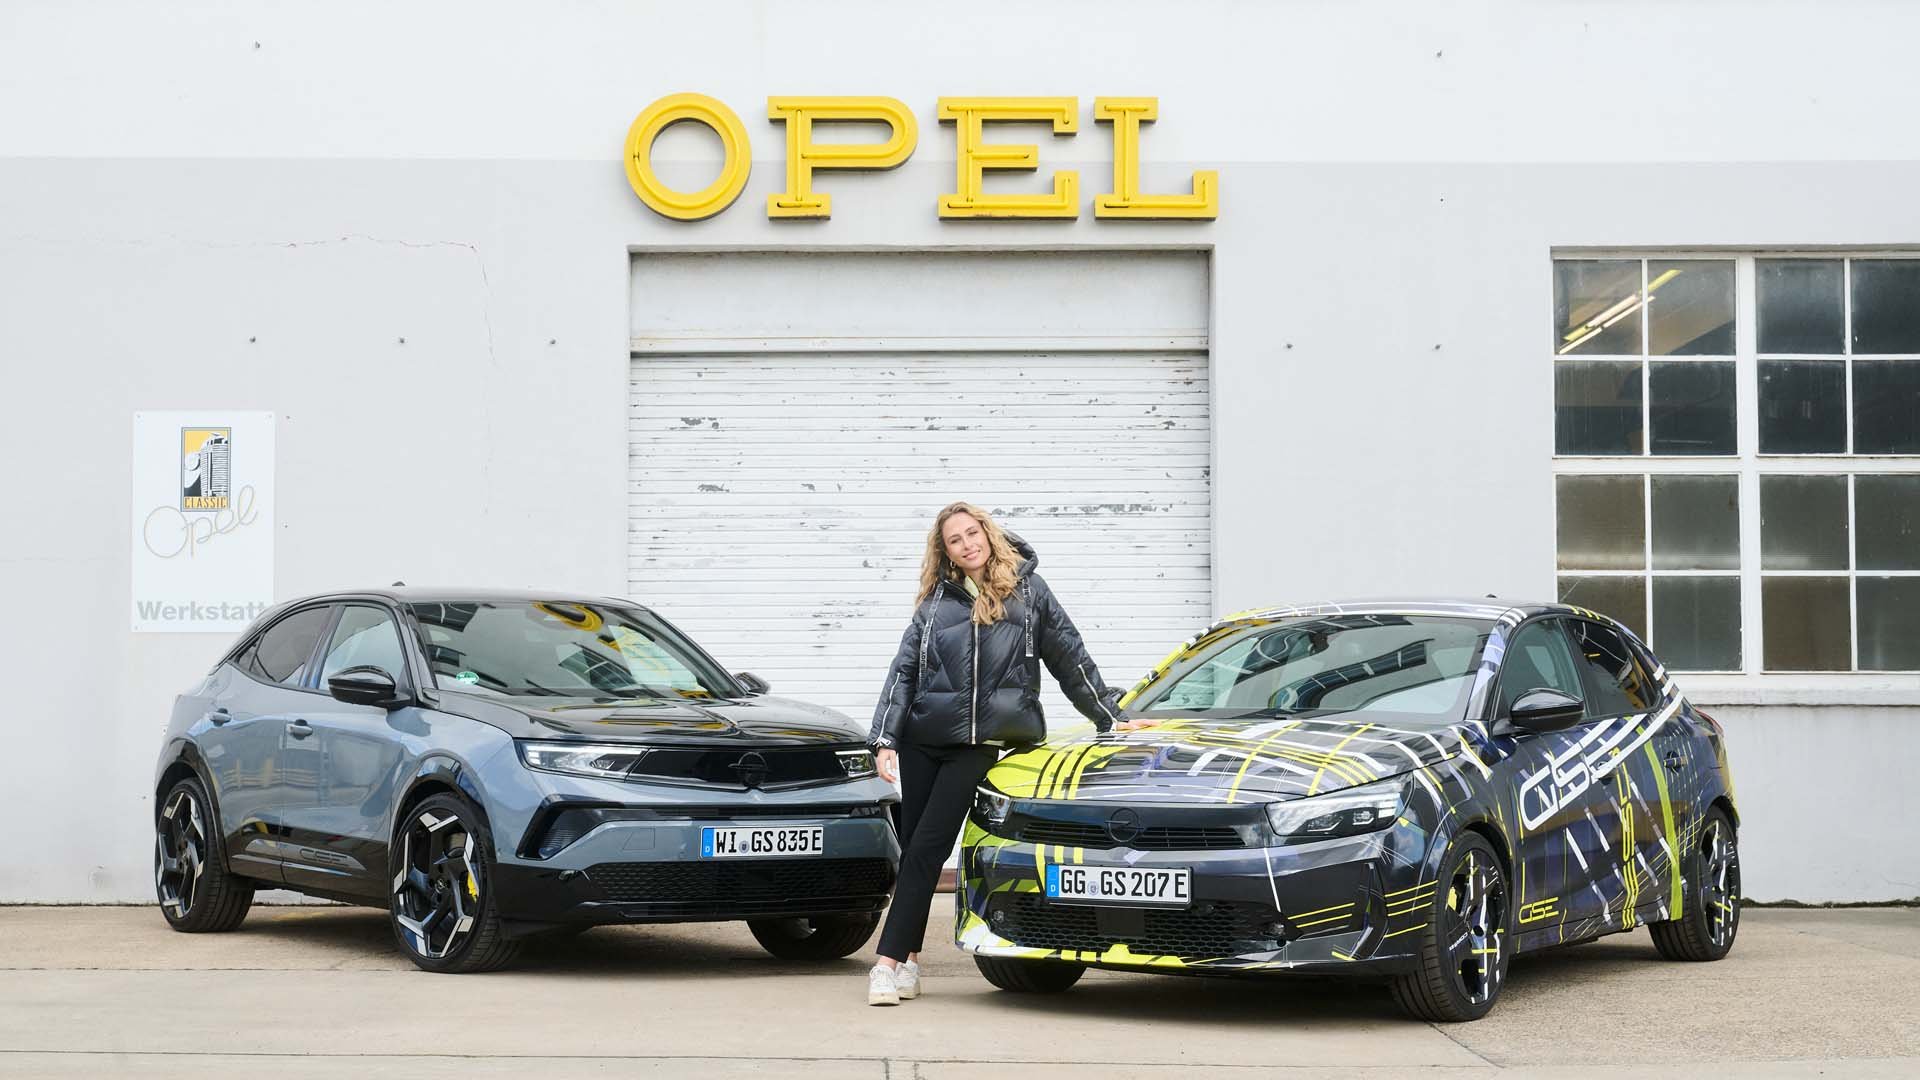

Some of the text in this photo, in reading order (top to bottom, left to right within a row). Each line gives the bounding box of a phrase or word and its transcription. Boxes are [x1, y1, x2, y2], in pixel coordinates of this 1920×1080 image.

[624, 92, 1219, 221] OPEL
[184, 497, 227, 508] CLASSIC
[144, 485, 258, 559] Opel
[716, 831, 737, 853] WI
[751, 831, 773, 852] GS
[1060, 869, 1085, 894] GG
[1100, 870, 1126, 896] GS
[1519, 896, 1559, 924] GSE
